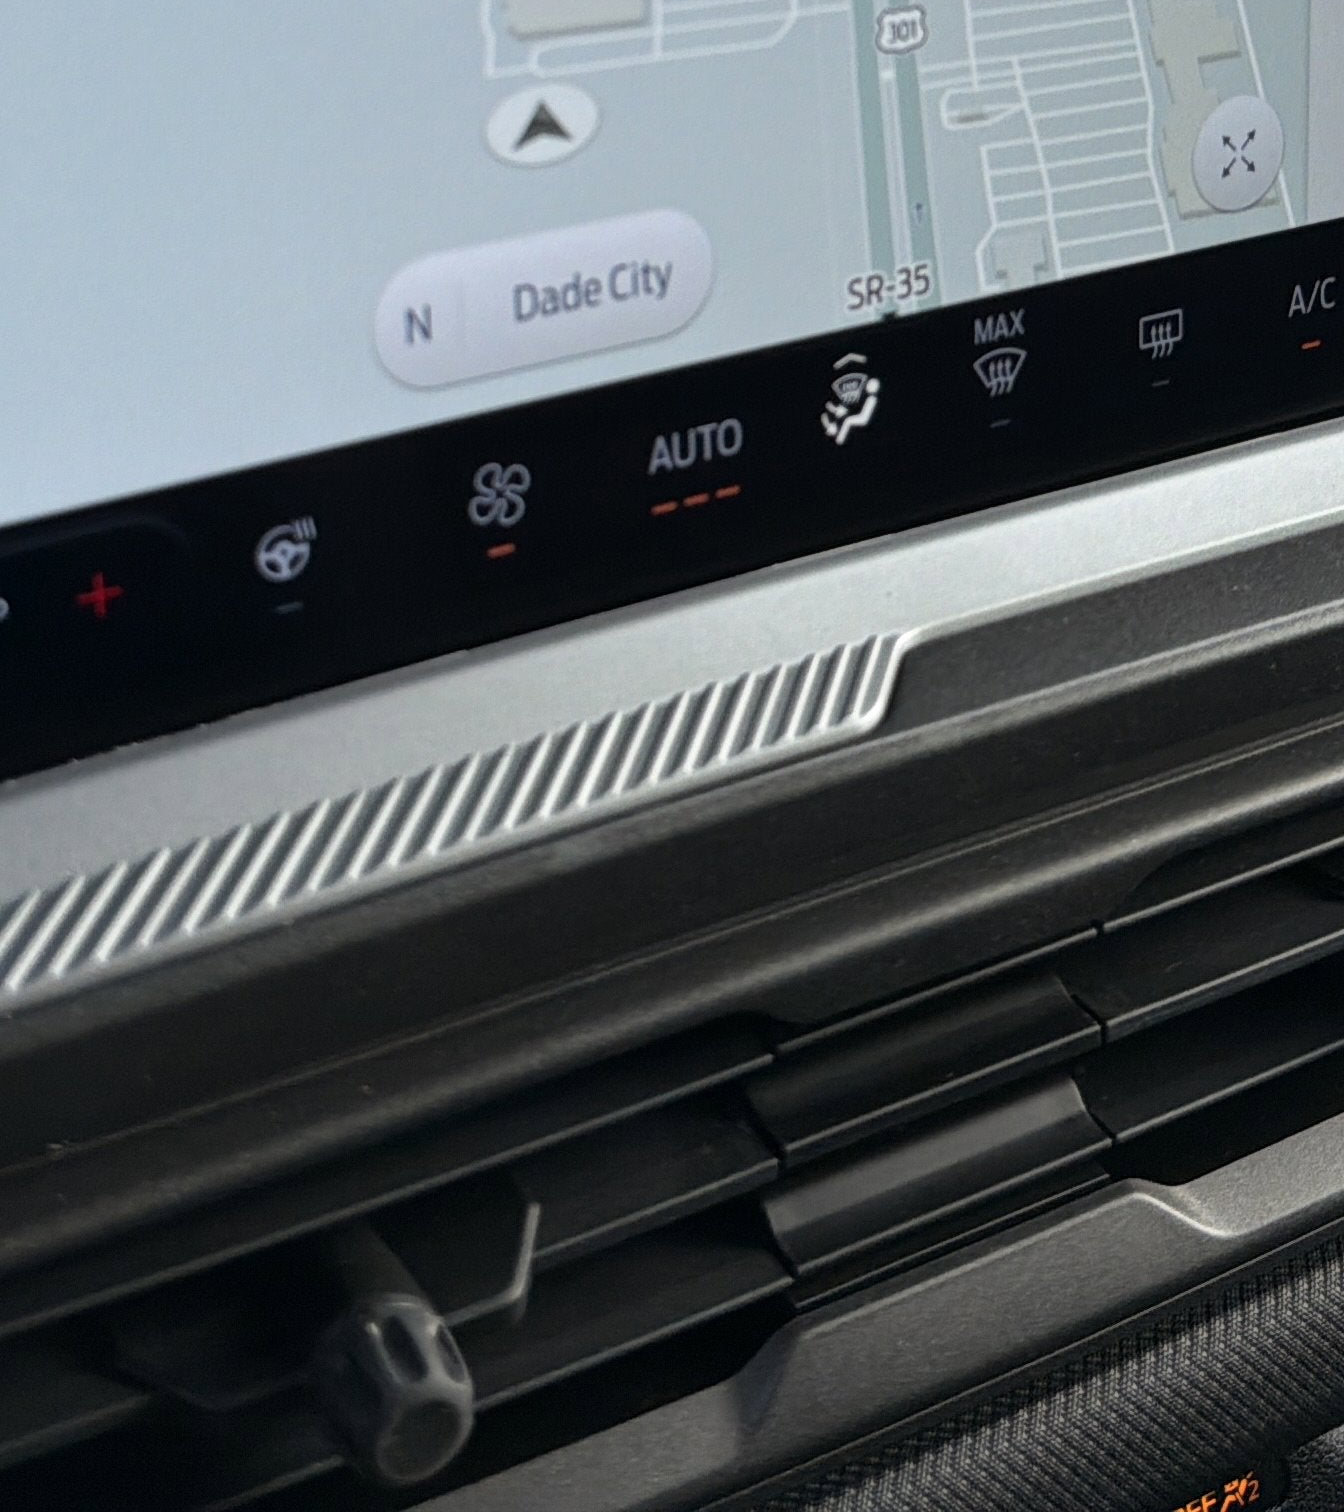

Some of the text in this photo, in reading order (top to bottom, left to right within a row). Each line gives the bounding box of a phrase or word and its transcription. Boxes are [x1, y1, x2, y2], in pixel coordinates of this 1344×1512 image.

[512, 258, 673, 324] Dade City
[846, 264, 931, 311] SR-35
[1288, 275, 1337, 319] A/C
[404, 303, 433, 346] N
[973, 308, 1026, 346] MAX
[648, 418, 743, 476] AUTO
